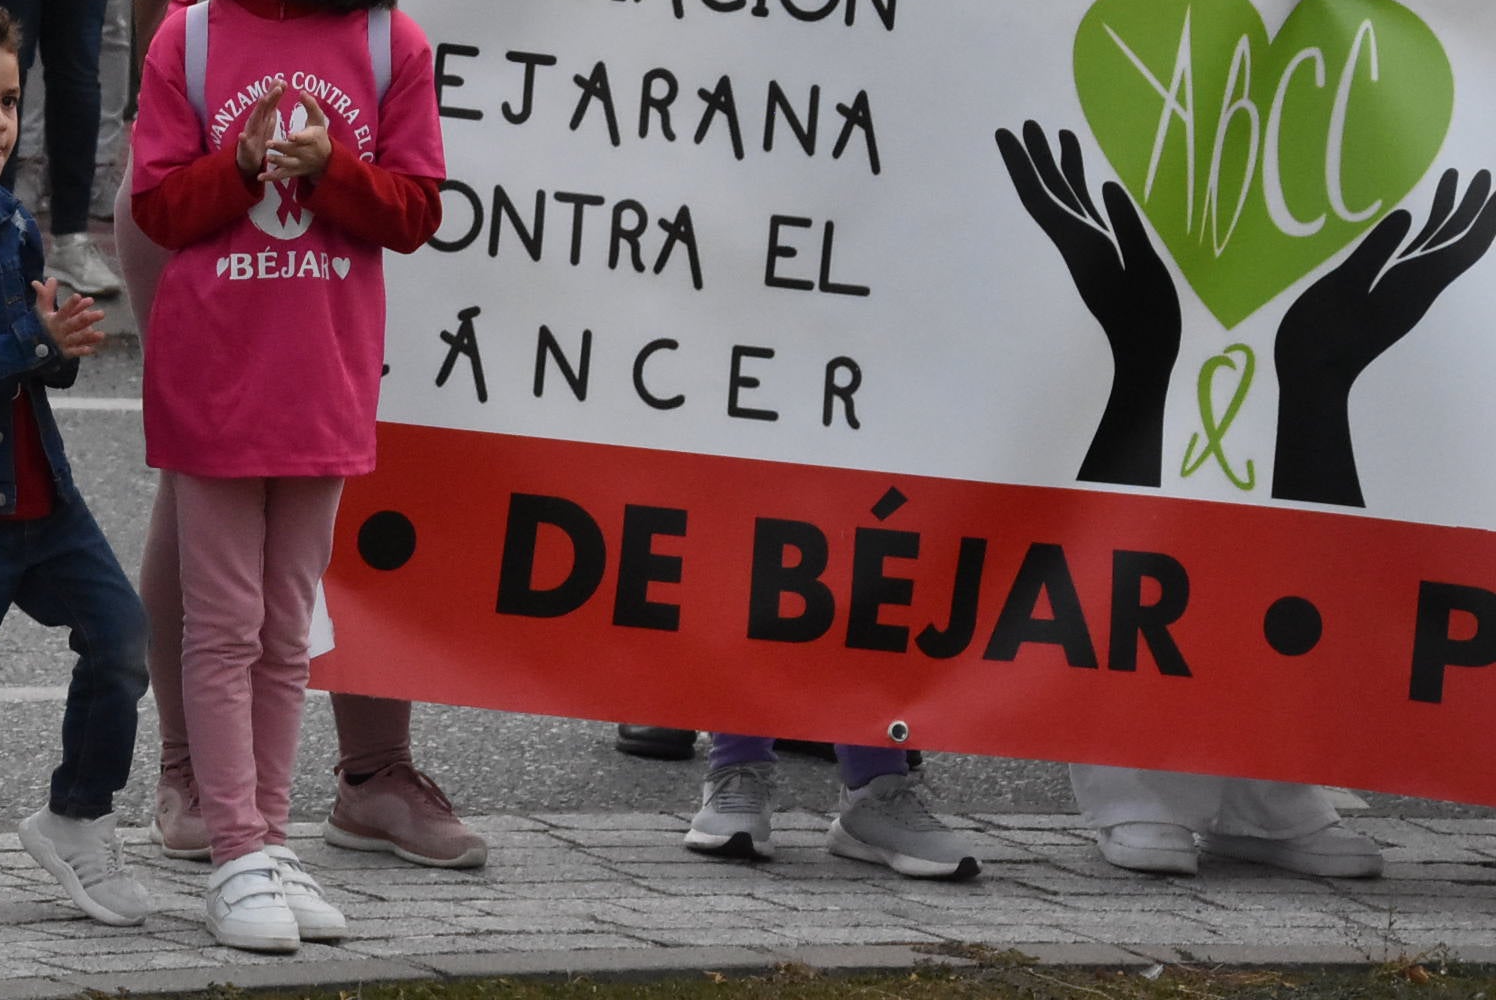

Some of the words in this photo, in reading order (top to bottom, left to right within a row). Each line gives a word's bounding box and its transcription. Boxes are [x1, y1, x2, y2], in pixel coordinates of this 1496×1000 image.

[291, 71, 362, 125] CONTRA
[354, 124, 371, 150] EL
[435, 42, 881, 176] EJARANA
[229, 246, 330, 280] BÉJAR
[426, 180, 704, 291] ONTRA
[764, 214, 871, 297] EL
[382, 306, 862, 430] ÁNCER
[496, 492, 688, 632] DE
[747, 487, 1194, 678] BÉJAR
